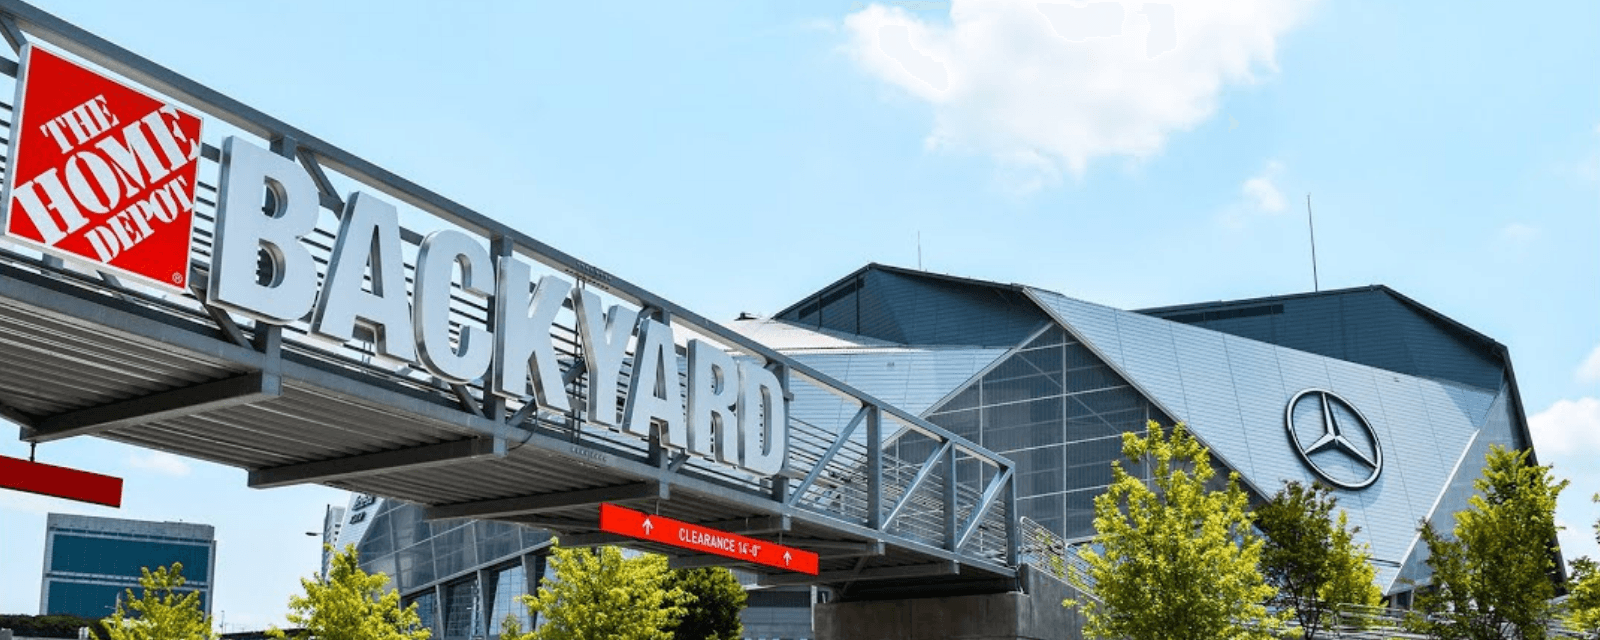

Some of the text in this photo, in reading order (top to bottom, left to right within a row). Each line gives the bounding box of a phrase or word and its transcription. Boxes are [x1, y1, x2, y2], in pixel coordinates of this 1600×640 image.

[39, 94, 120, 155] THE
[13, 103, 201, 246] HOME
[85, 175, 194, 264] DEPOT
[207, 135, 786, 477] BACKYARD
[678, 528, 735, 552] CLEARANCE
